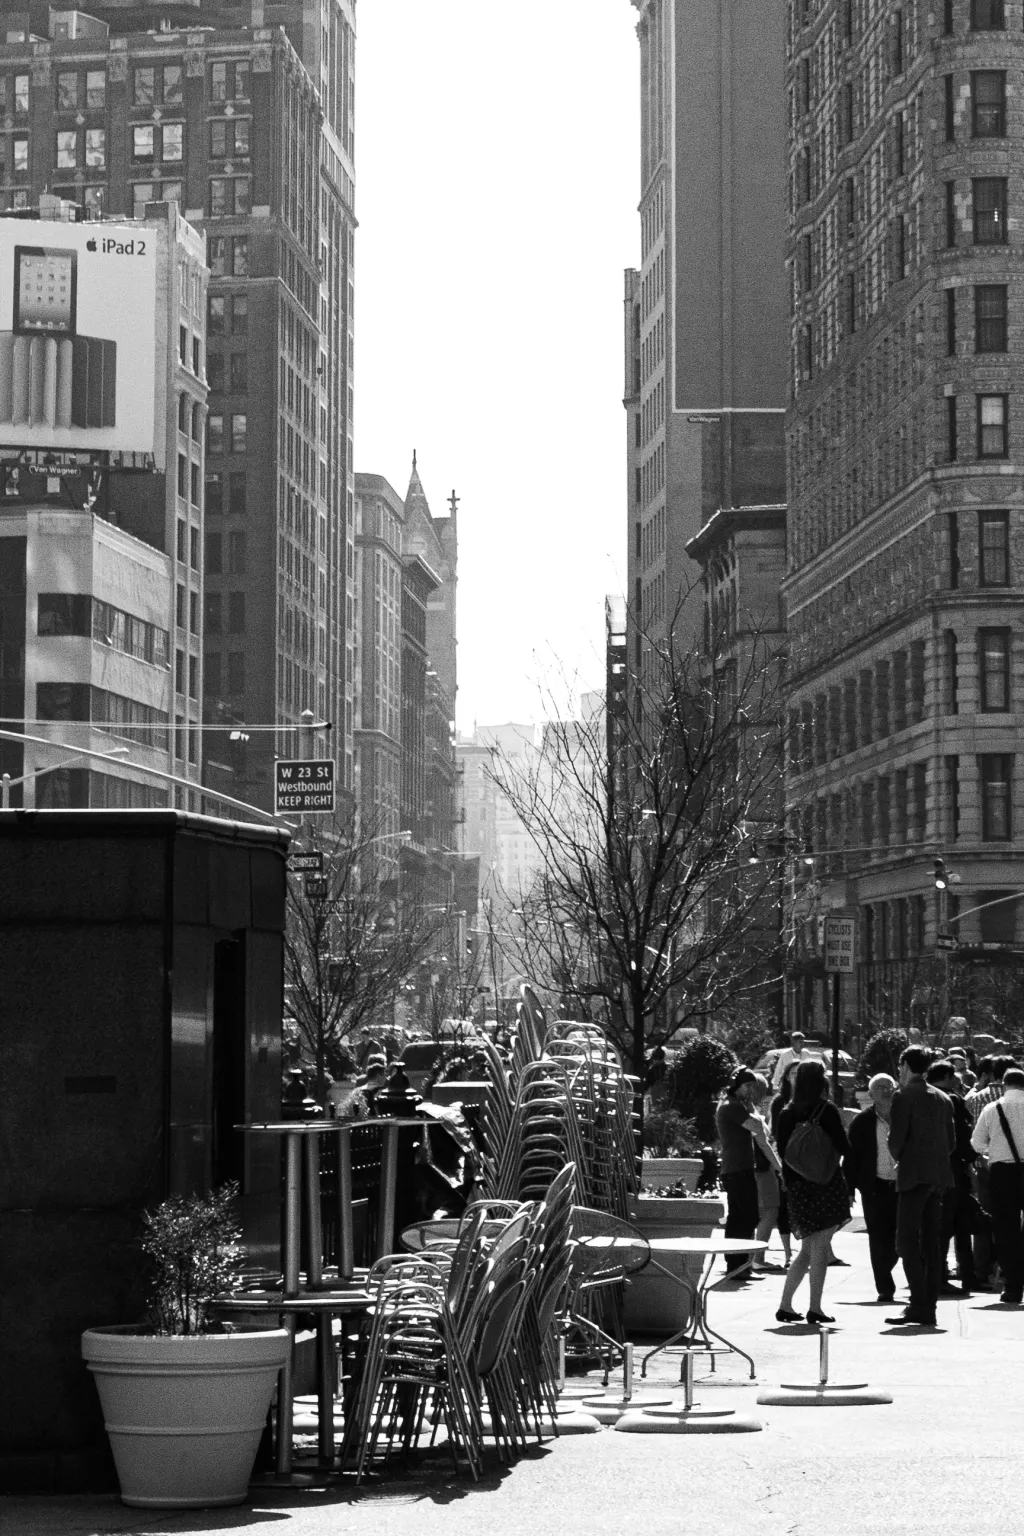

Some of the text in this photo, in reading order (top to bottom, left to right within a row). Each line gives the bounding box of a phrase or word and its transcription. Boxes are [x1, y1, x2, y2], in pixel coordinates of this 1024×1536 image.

[102, 238, 146, 256] iPad 2
[49, 466, 78, 476] Wagner
[281, 767, 329, 778] W 23 St
[278, 780, 332, 792] Westbound
[278, 795, 332, 806] KEEP RIGHT
